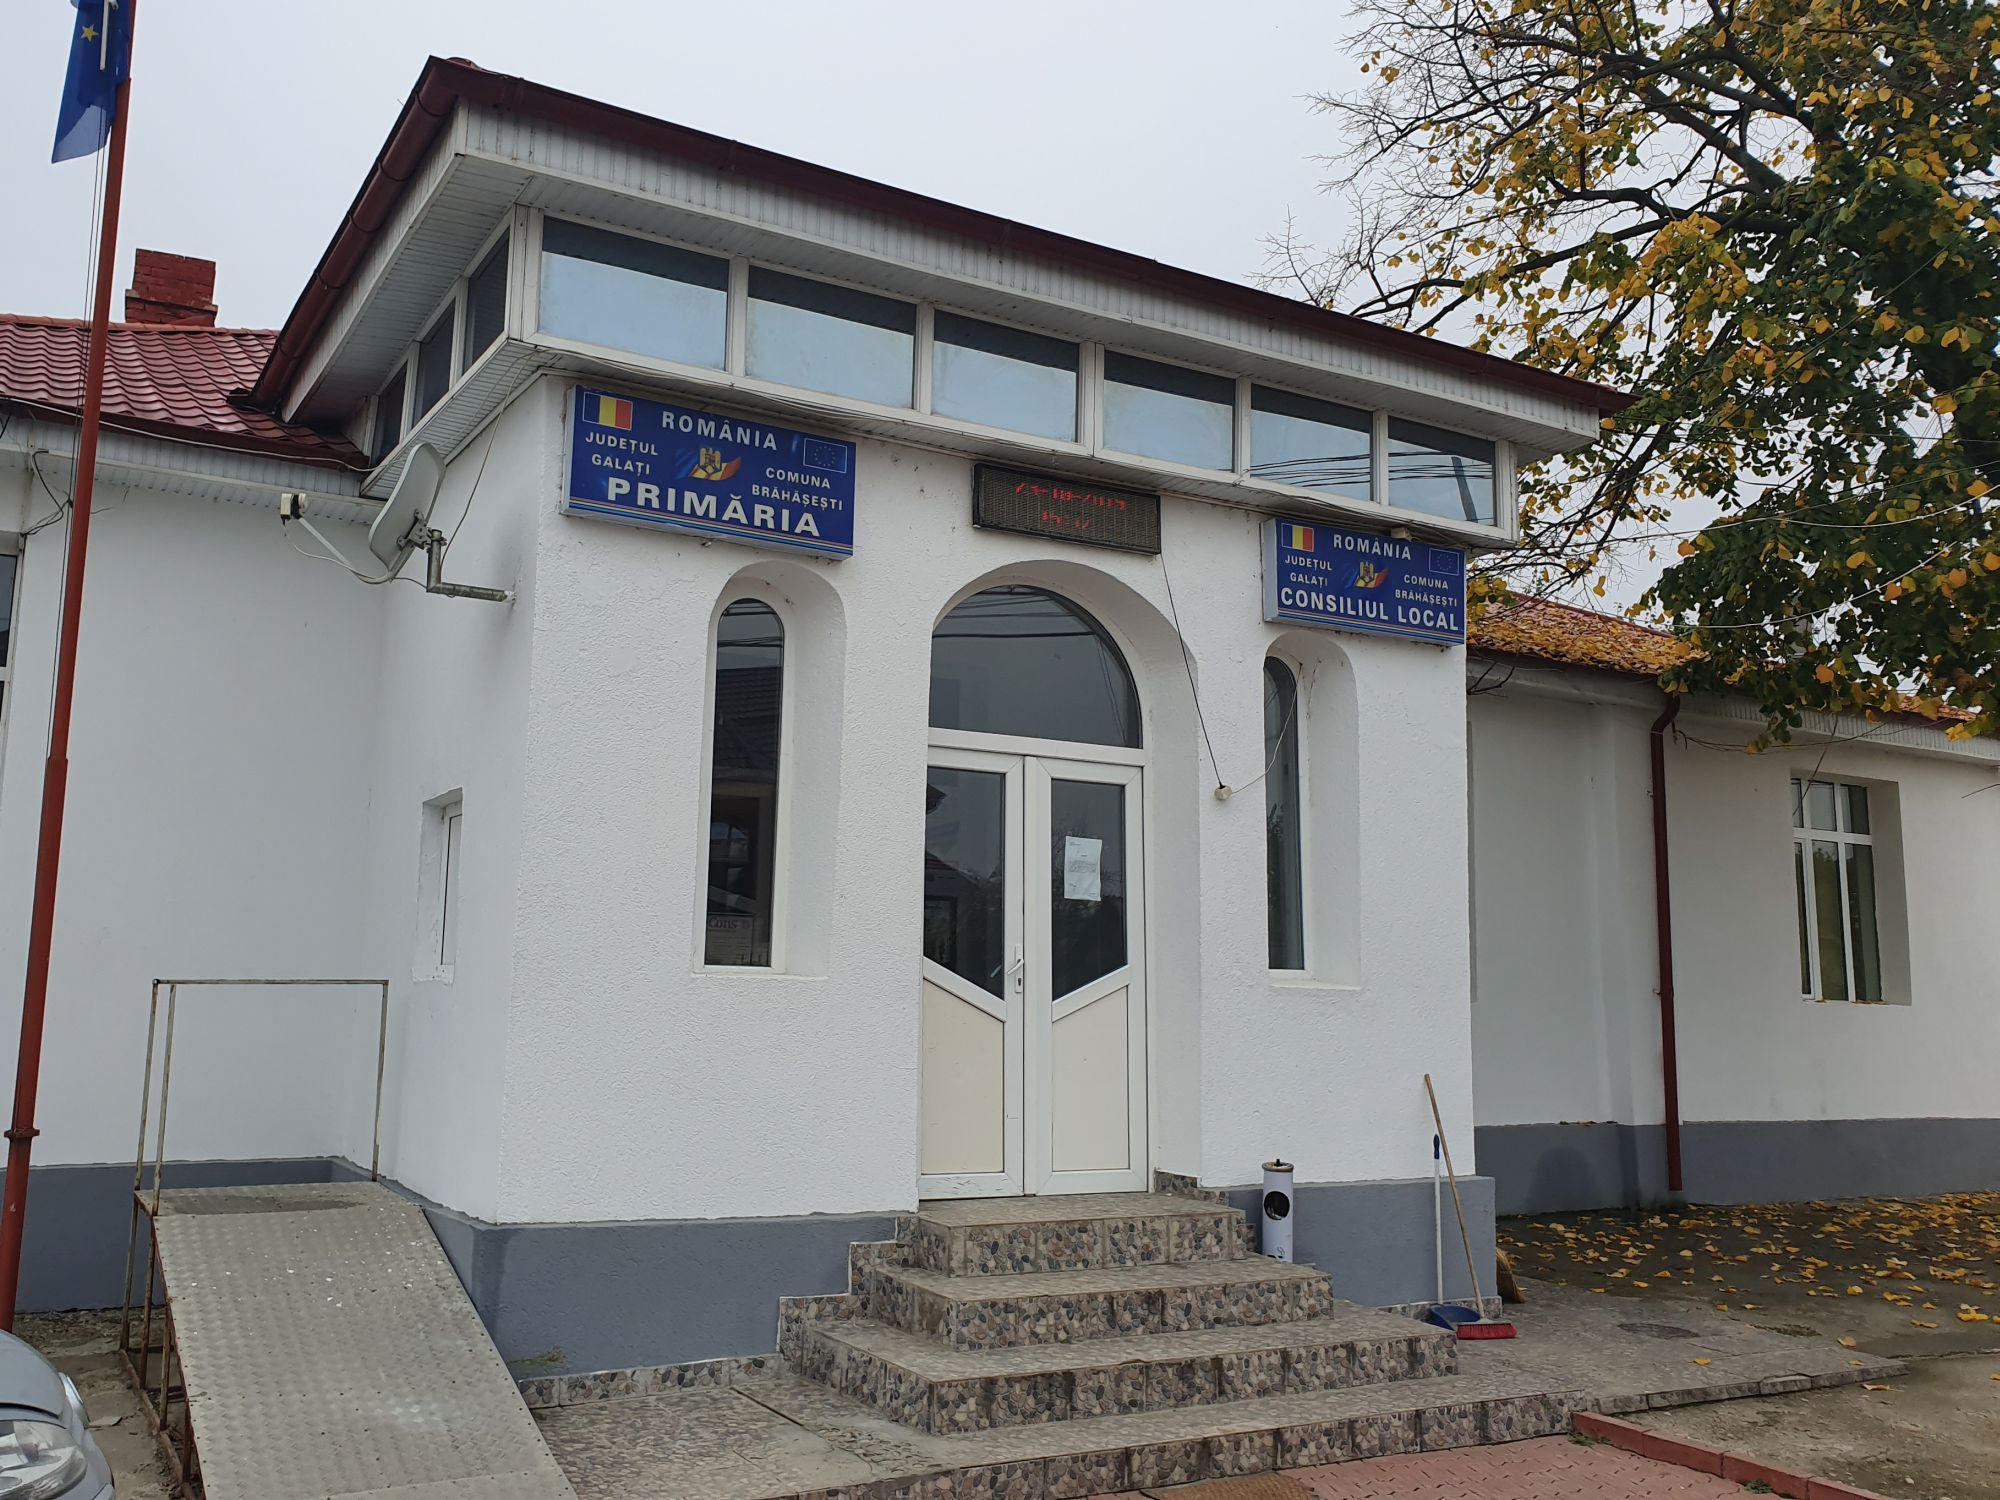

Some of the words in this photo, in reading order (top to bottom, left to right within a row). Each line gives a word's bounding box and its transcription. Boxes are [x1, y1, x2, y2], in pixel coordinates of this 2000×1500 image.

[662, 411, 777, 451] ROMÂNIA
[585, 432, 658, 456] JUDEȚUL
[591, 454, 650, 477] GALAȚI
[766, 467, 831, 489] COMUNA
[607, 477, 820, 537] PRIMĂRIA
[752, 484, 843, 511] BRĂHĂȘEȘTI
[1333, 534, 1411, 560] ROMÂNIA
[1285, 555, 1333, 571] JUDEȚUL
[1290, 572, 1328, 588] GALAȚI
[1404, 574, 1448, 590] COMUNA
[1281, 587, 1389, 621] CONSILIUL
[1398, 605, 1459, 631] LOCAL
